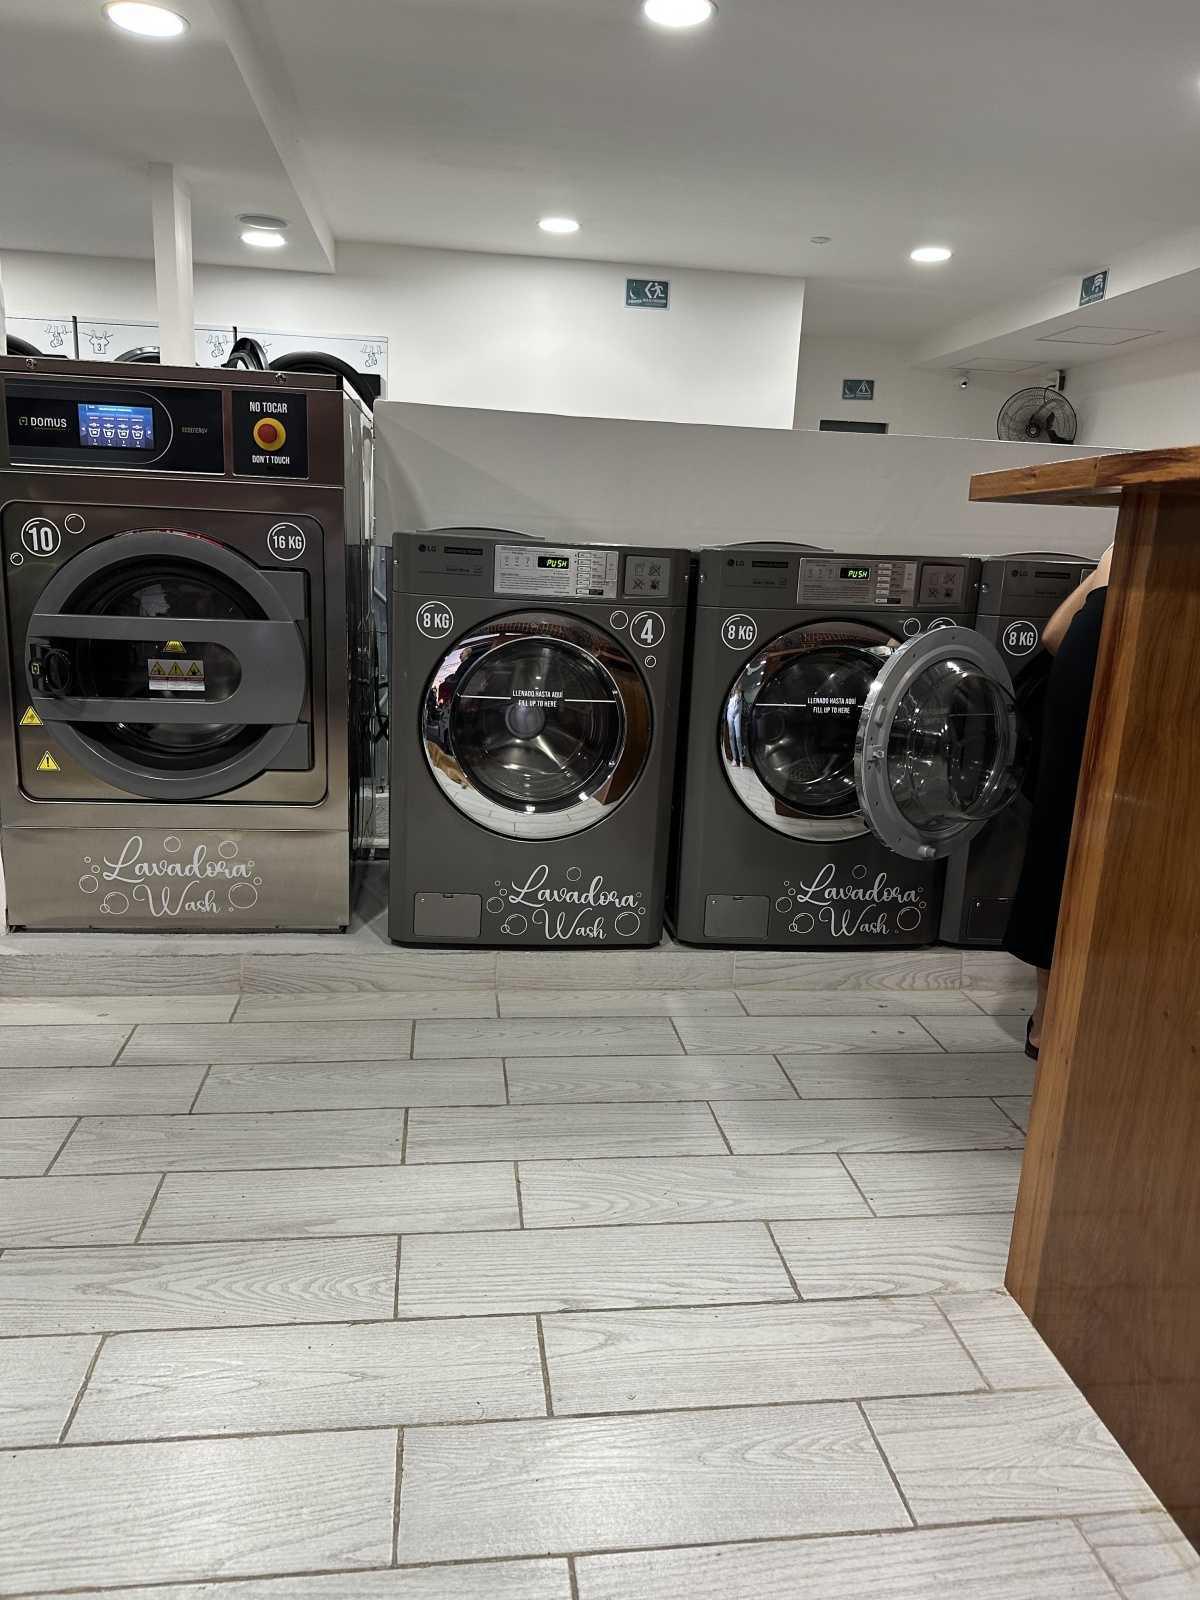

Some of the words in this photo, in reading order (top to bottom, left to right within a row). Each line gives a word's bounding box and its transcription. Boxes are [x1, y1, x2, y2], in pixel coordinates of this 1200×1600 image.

[249, 401, 261, 412] NO
[262, 402, 288, 413] TOCAR
[30, 416, 67, 428] DOMUS
[252, 455, 270, 464] DON'T
[271, 456, 290, 465] TOUCH
[27, 526, 53, 551] 10
[273, 535, 286, 549] 16
[288, 535, 303, 550] KG
[546, 559, 568, 568] PUSH
[848, 569, 869, 578] PUSH
[423, 612, 432, 627] 8
[434, 613, 450, 629] KG
[640, 619, 654, 644] 4
[728, 625, 737, 640] 8
[738, 625, 754, 640] KG
[1008, 631, 1017, 646] 8
[1019, 631, 1035, 646] KG
[518, 699, 528, 707] FILL
[544, 700, 558, 708] HERE
[102, 835, 252, 884] Lavadora
[508, 864, 639, 908] Lavadora
[796, 863, 920, 906] Lavadora
[132, 880, 221, 918] Wash
[532, 907, 607, 940] Wash
[818, 903, 891, 937] Wash
